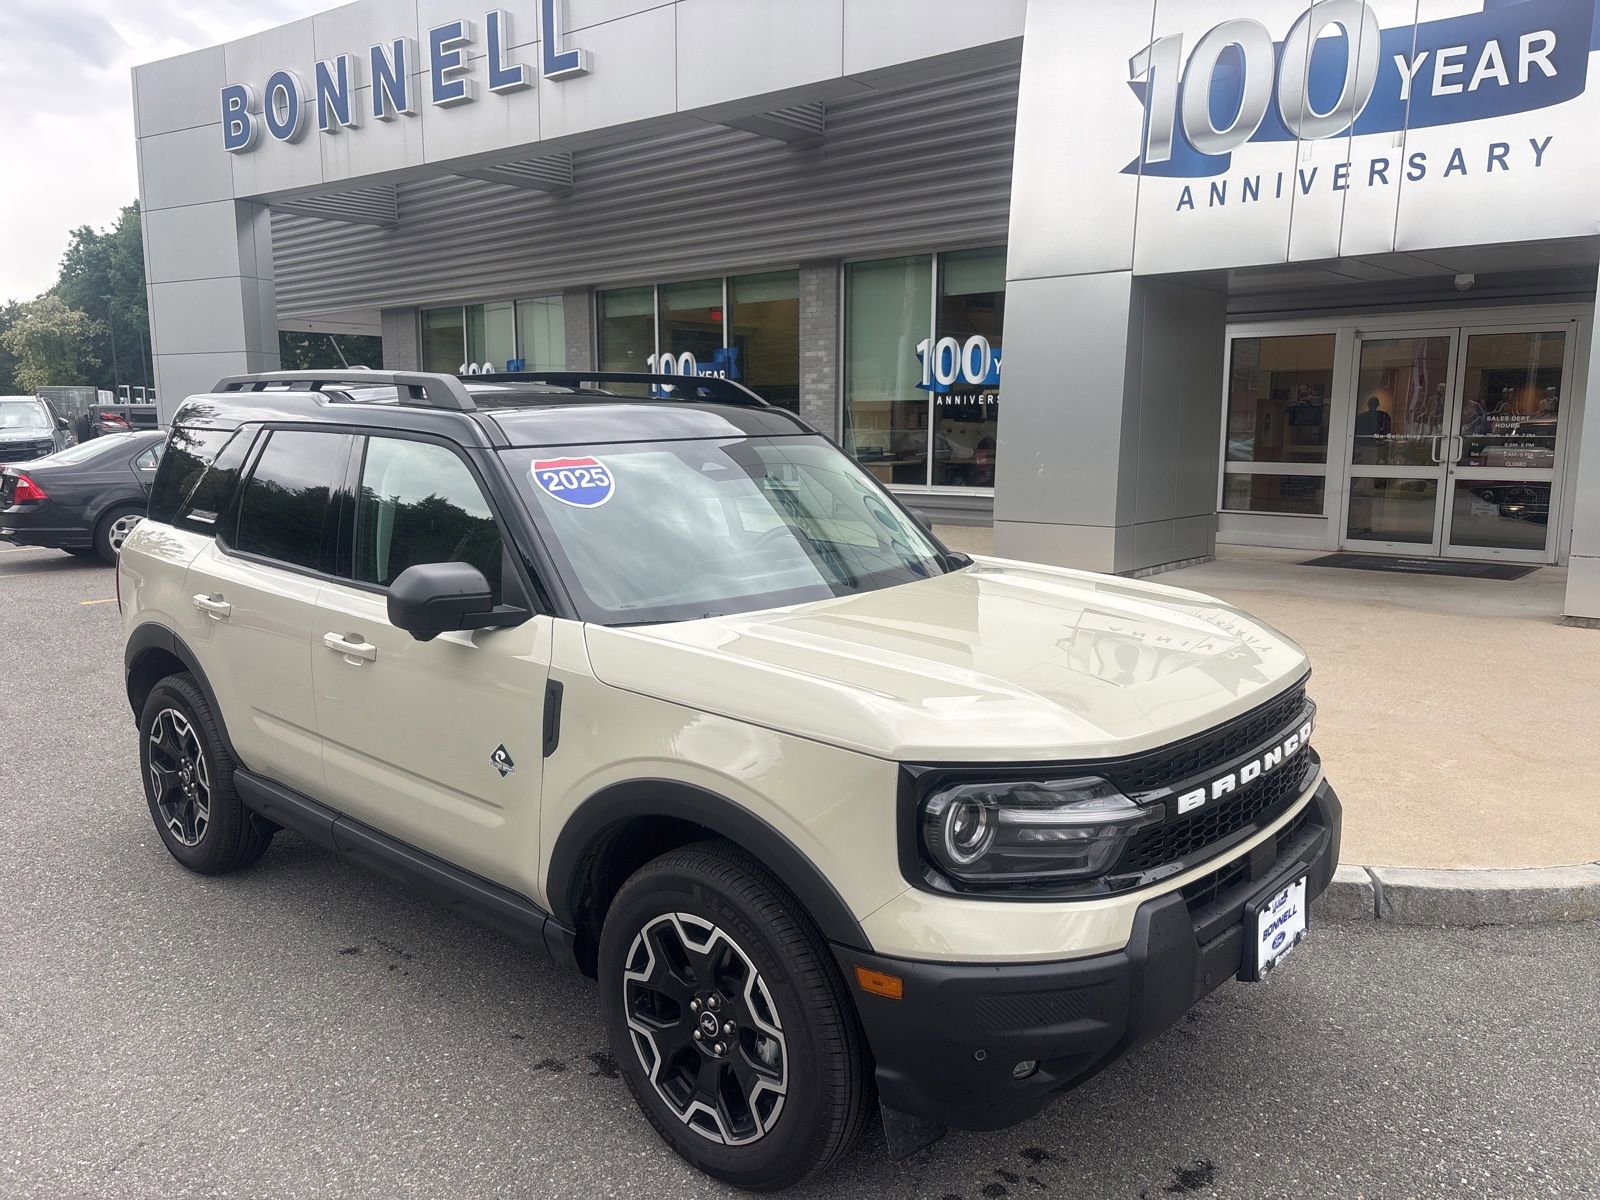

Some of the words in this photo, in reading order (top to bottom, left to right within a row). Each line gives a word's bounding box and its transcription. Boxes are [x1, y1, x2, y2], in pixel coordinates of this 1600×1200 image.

[220, 0, 592, 154] BONNELL
[1128, 0, 1382, 164] 100
[1393, 28, 1558, 101] YEAR
[1175, 136, 1554, 212] ANNIVERSARY
[916, 335, 991, 385] 100
[542, 468, 610, 491] 2025
[1177, 721, 1312, 815] BRONCO
[1262, 904, 1298, 942] BONNELL
